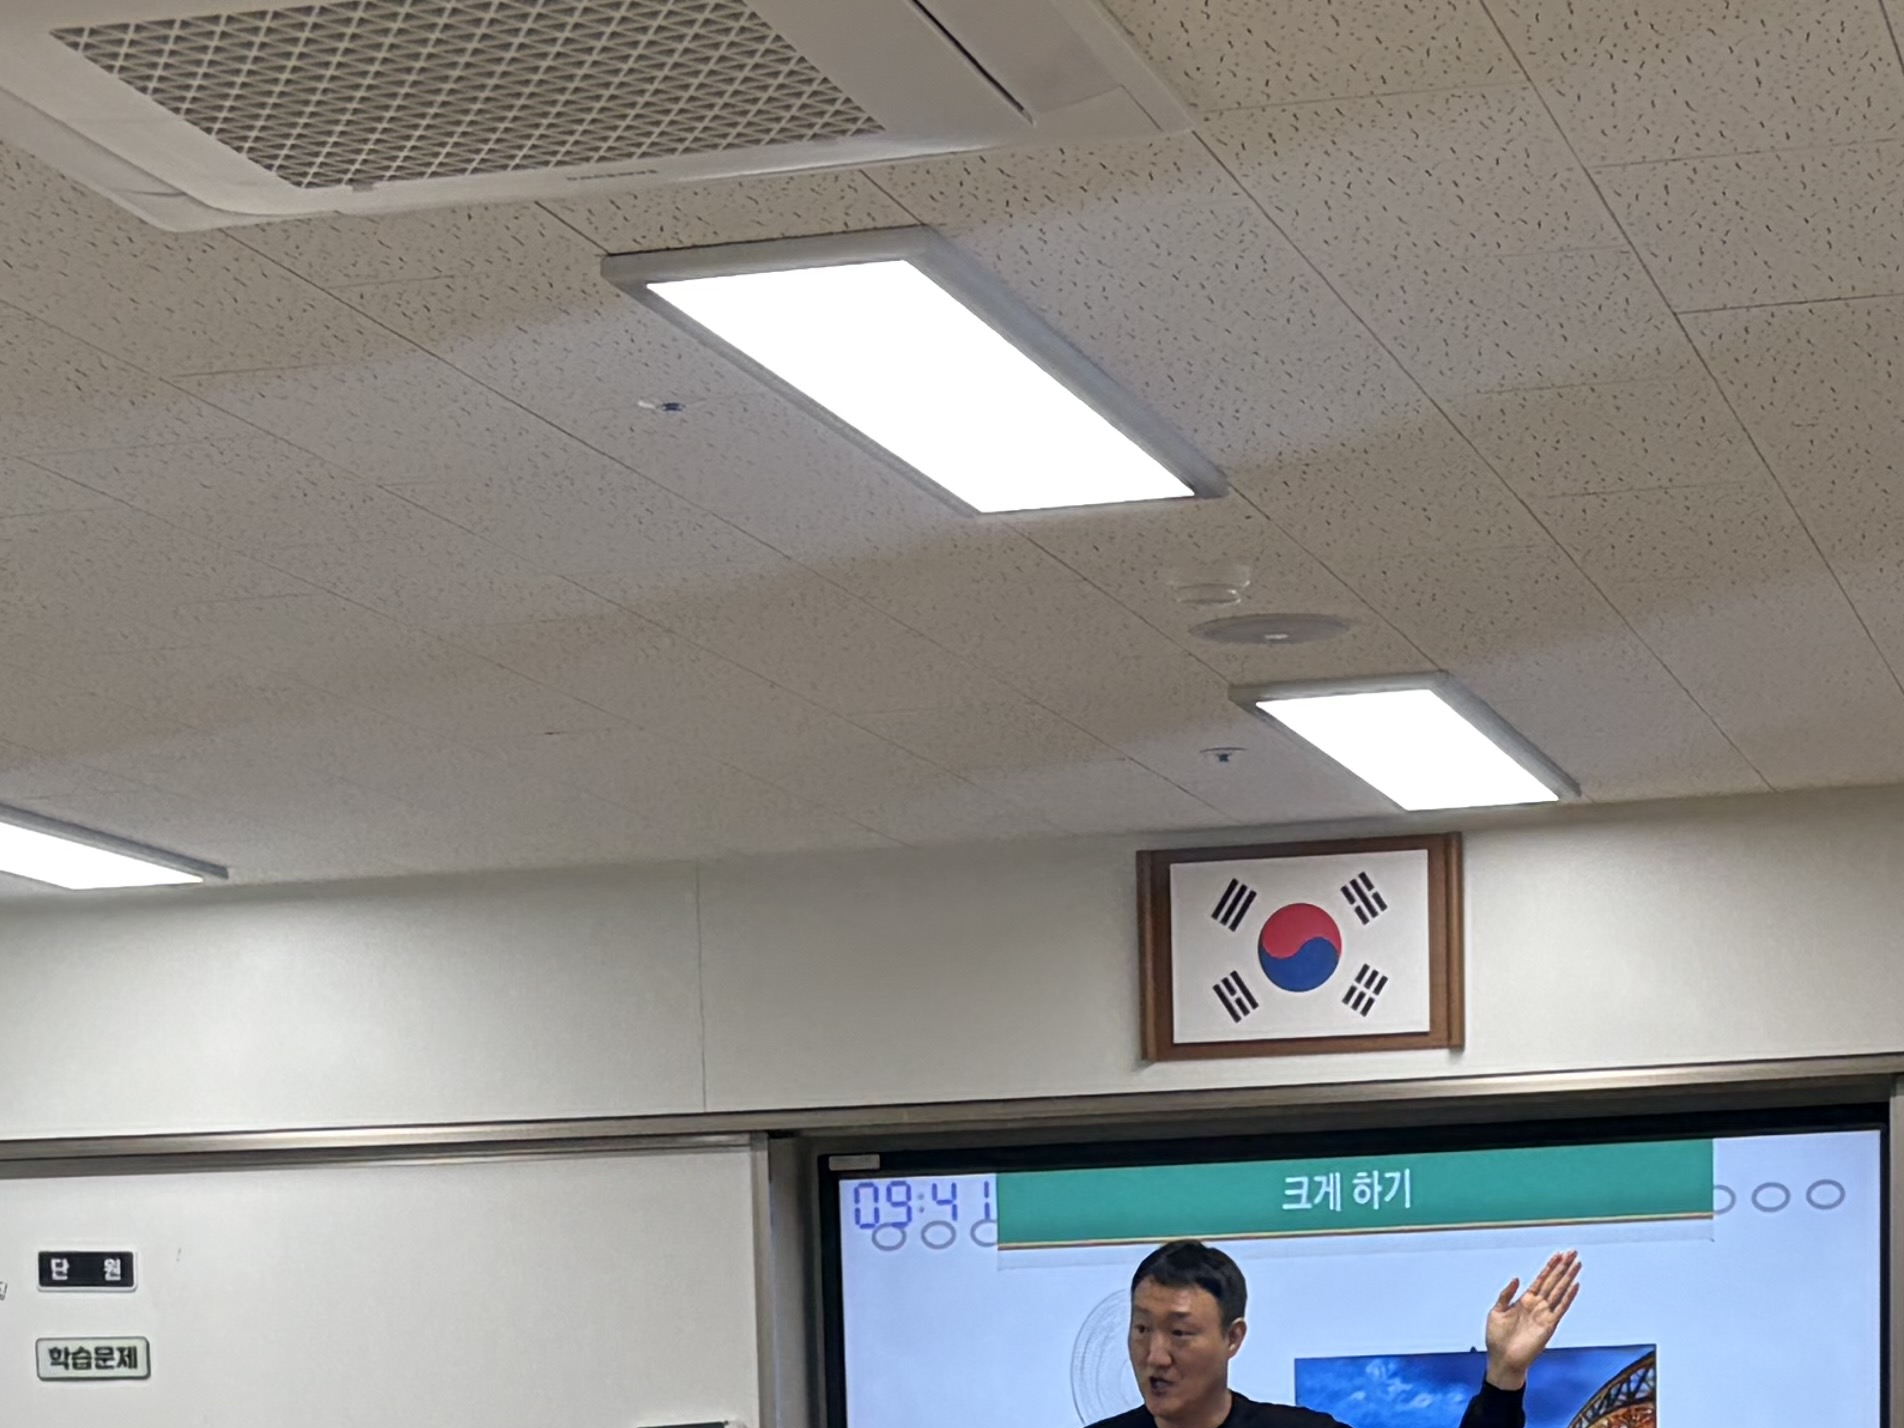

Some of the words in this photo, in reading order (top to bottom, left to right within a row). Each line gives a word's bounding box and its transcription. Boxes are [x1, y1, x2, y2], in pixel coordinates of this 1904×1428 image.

[1282, 1172, 1342, 1212] 크게
[1352, 1168, 1411, 1210] 하기
[50, 1257, 70, 1281] 단
[104, 1257, 122, 1282] 원
[48, 1346, 138, 1370] 학습문제
